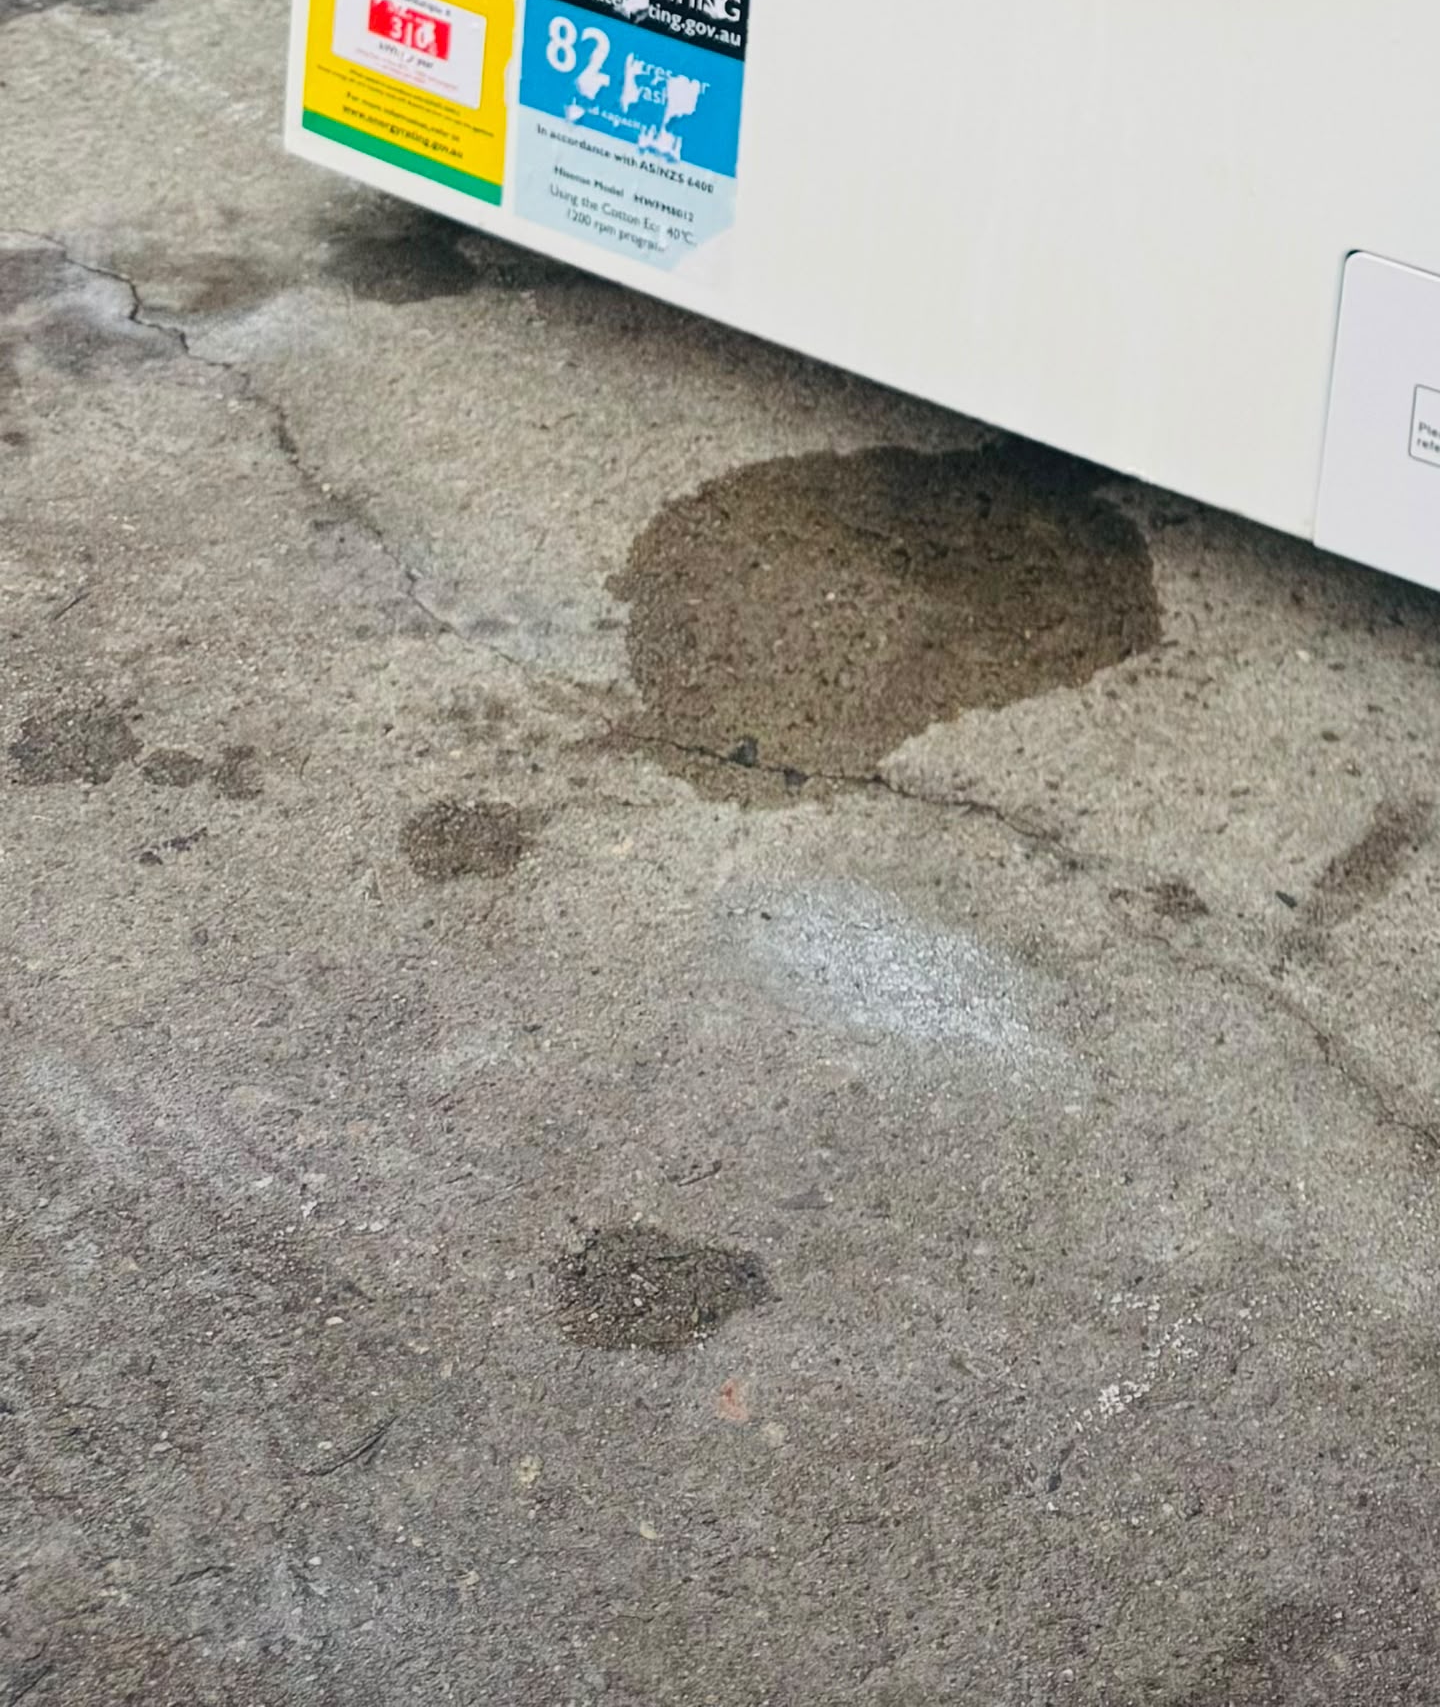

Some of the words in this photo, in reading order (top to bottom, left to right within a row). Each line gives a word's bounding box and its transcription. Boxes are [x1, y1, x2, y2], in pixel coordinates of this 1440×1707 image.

[546, 16, 611, 95] 82
[536, 124, 548, 136] In
[550, 132, 612, 159] accordance
[613, 153, 638, 168] with
[550, 182, 579, 207] Using
[581, 194, 599, 212] the
[602, 203, 641, 228] Cotton
[566, 207, 592, 226] 1200
[594, 220, 617, 237] rpm
